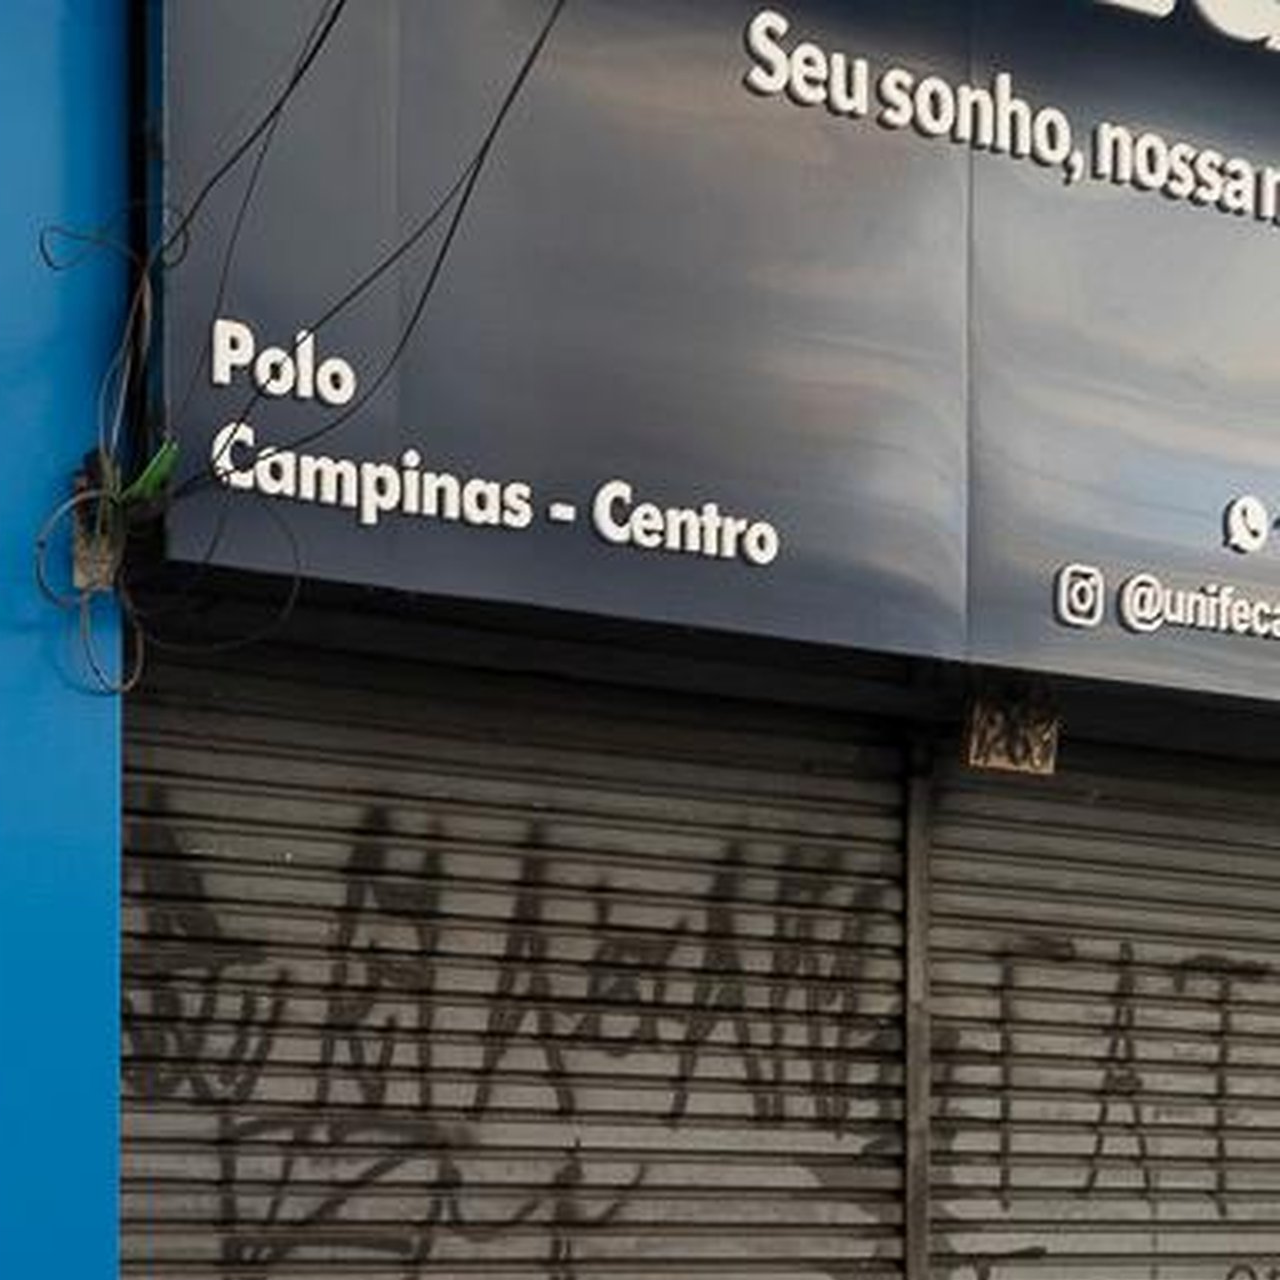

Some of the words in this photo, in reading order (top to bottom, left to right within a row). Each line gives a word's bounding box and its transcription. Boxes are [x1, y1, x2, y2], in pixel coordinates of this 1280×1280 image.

[745, 9, 869, 116] Seu
[878, 68, 1085, 184] sonho,
[1096, 121, 1255, 215] nossa
[211, 318, 357, 405] Polo
[210, 421, 533, 530] Campinas
[592, 479, 780, 566] Centro
